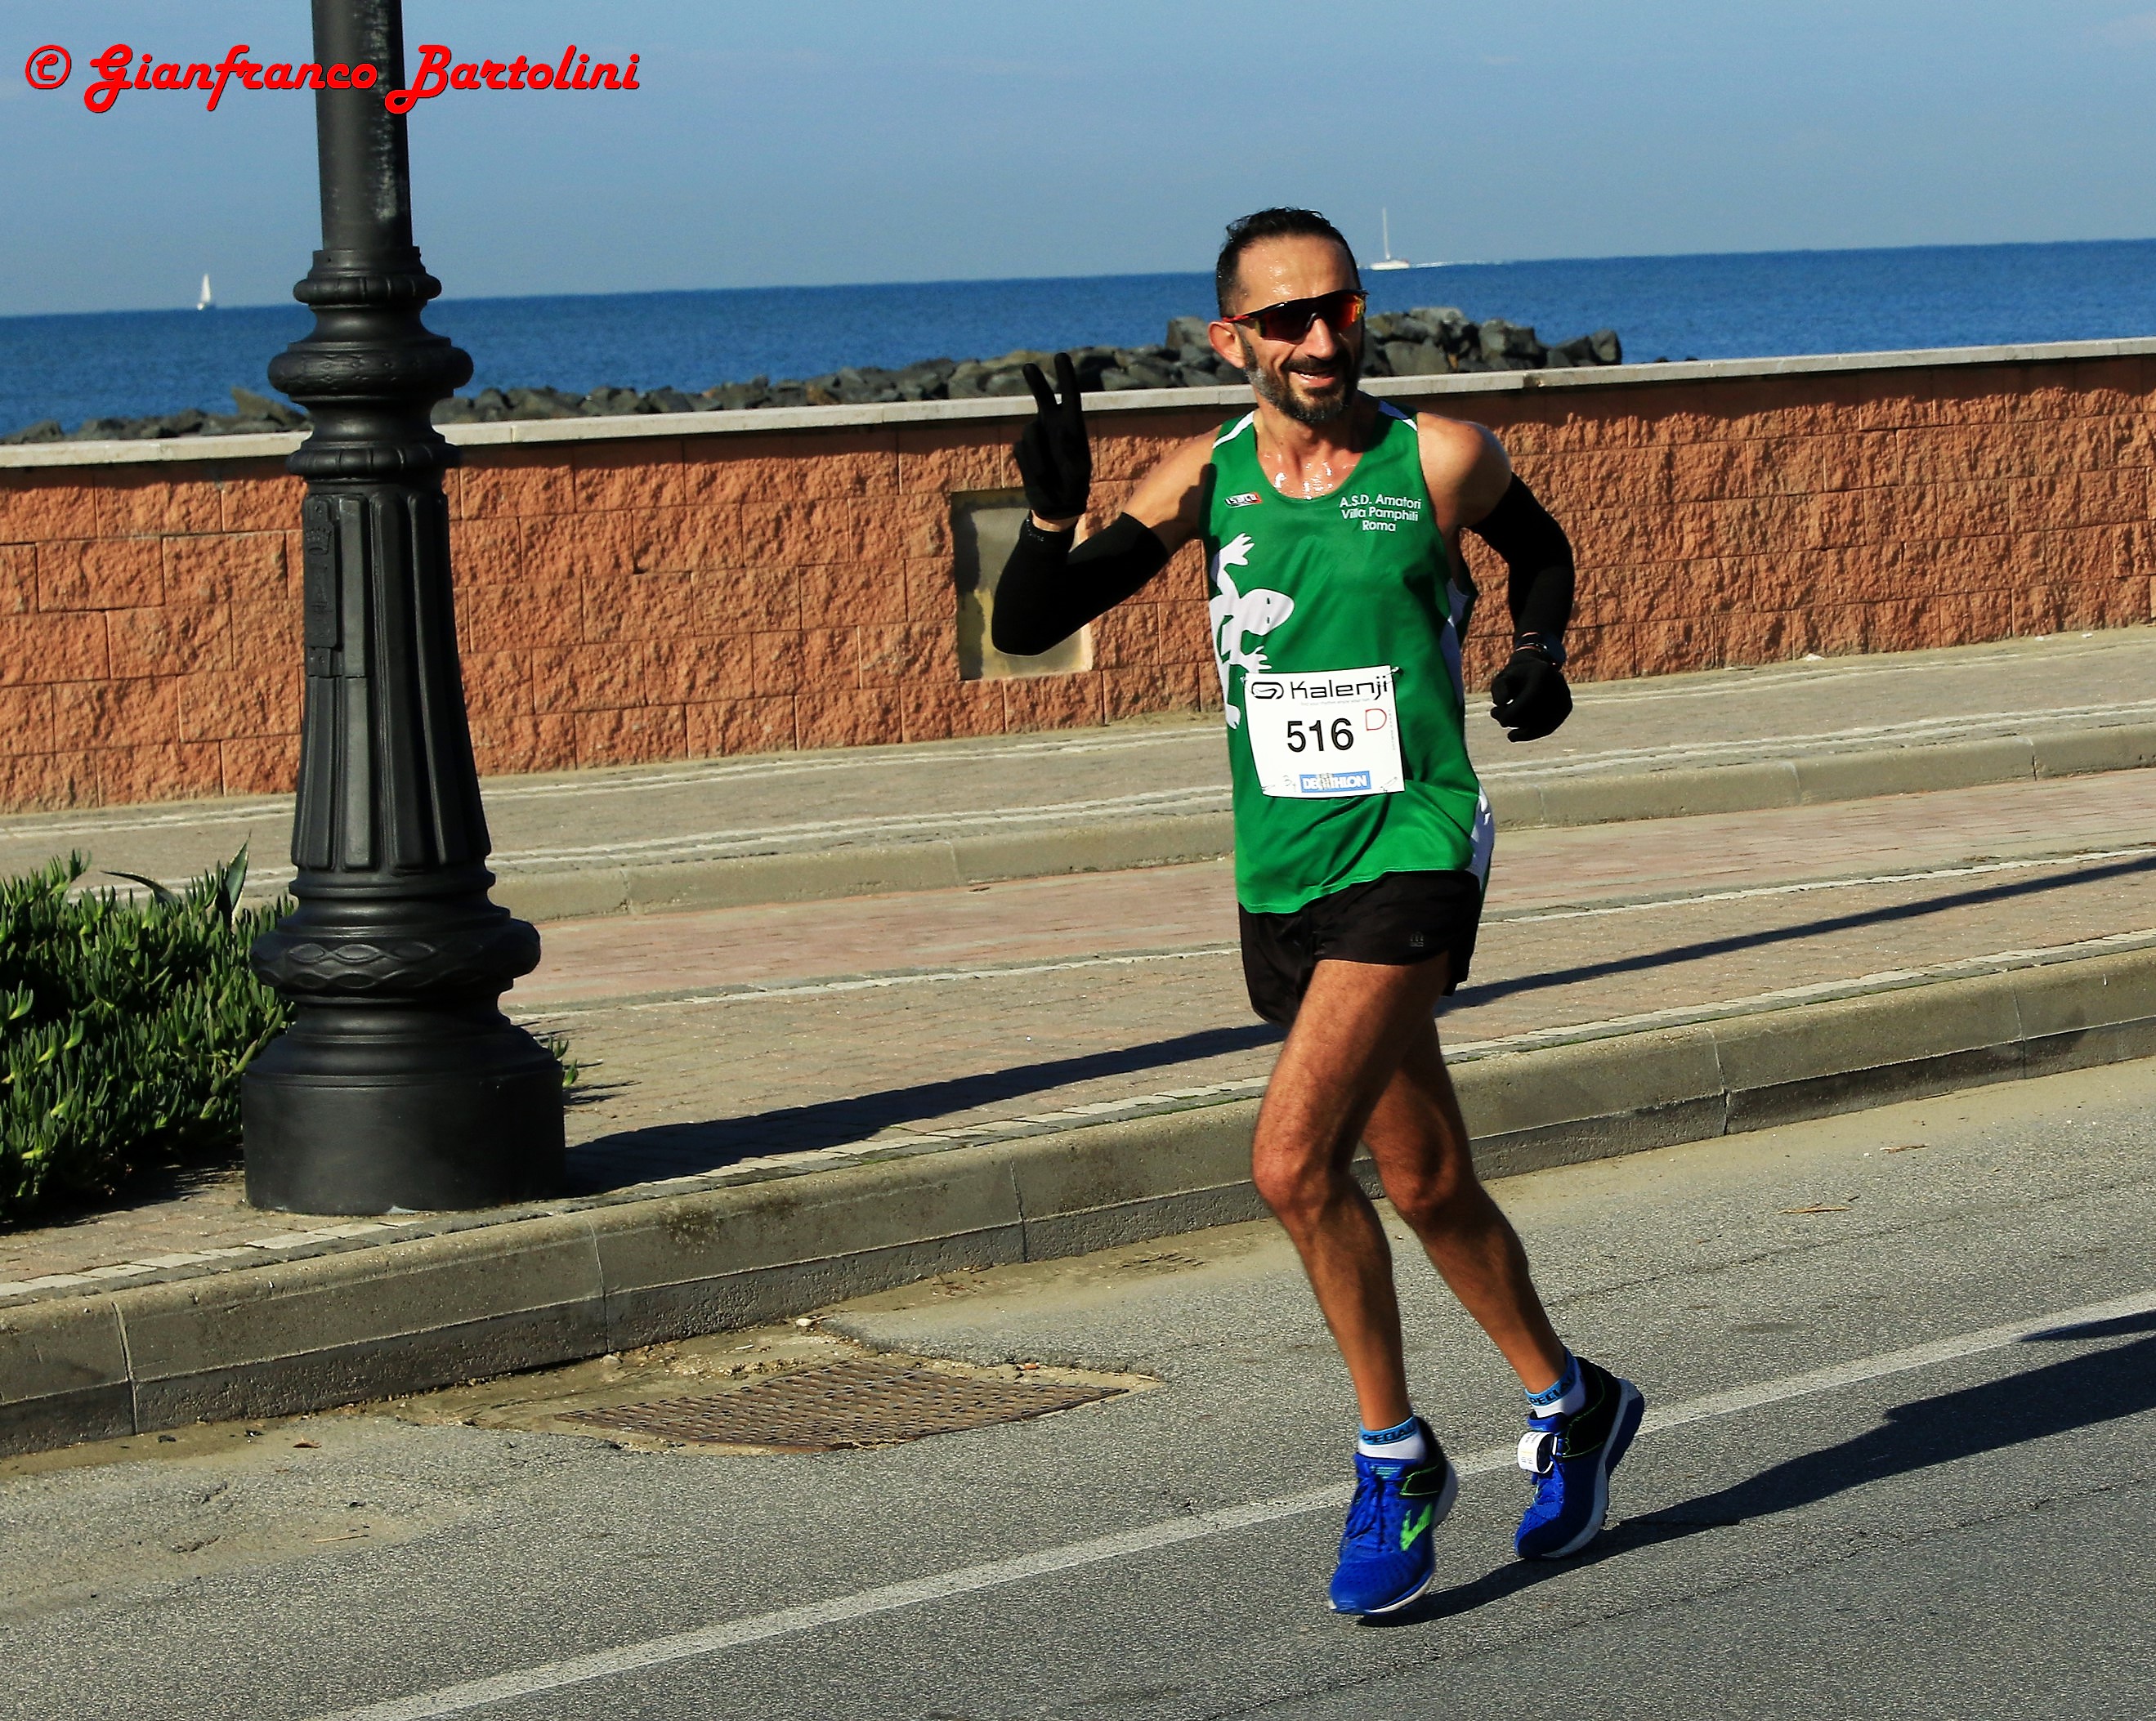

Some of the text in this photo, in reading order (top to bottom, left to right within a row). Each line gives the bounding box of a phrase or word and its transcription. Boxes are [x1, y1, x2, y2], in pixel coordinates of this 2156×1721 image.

[1340, 494, 1422, 509] A.S.D. Amatori
[1341, 506, 1419, 521] Villa Pamphili
[1362, 520, 1397, 531] Roma
[1290, 675, 1388, 700] Kalenji
[1365, 708, 1388, 731] D
[1287, 717, 1354, 753] 516
[1301, 773, 1368, 790] DETHLON
